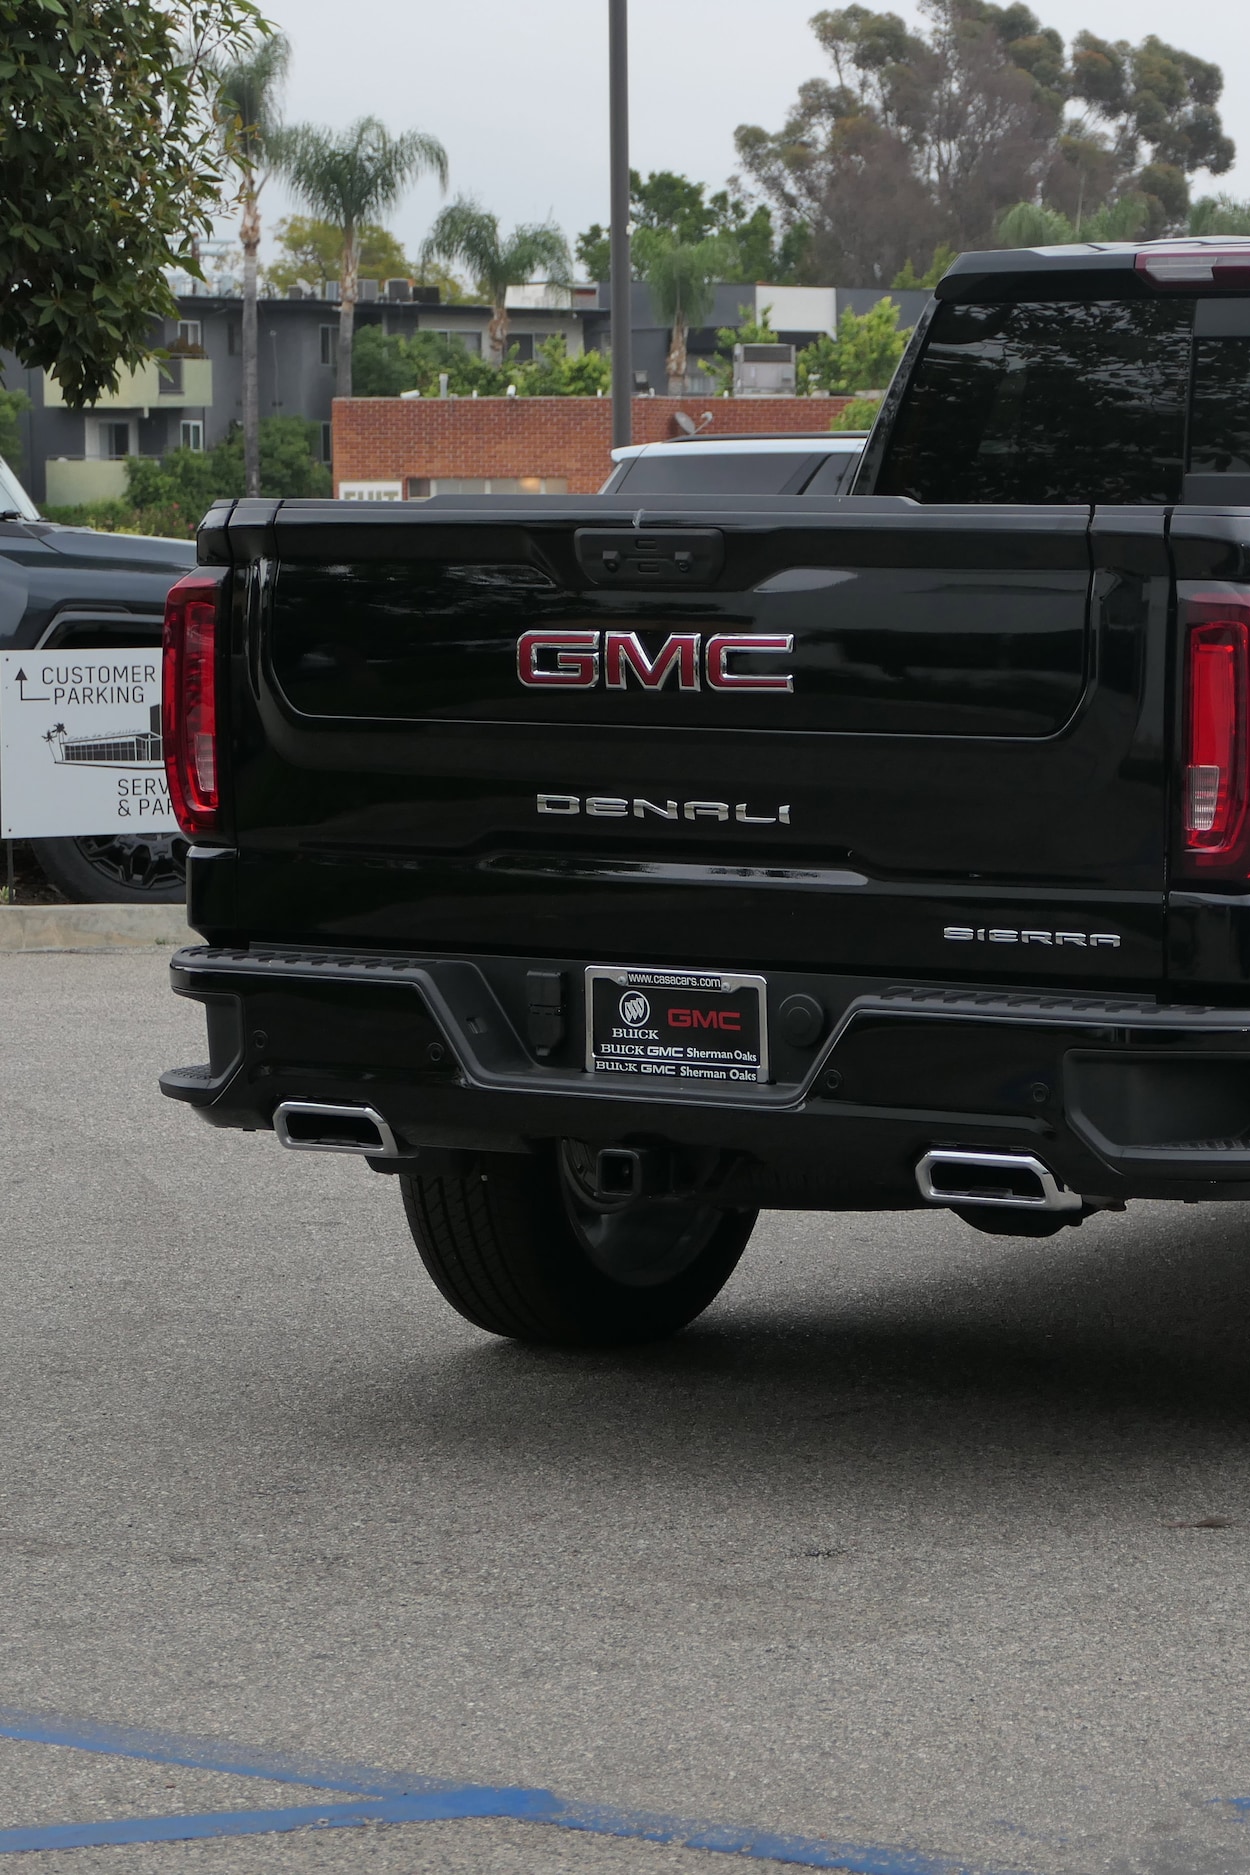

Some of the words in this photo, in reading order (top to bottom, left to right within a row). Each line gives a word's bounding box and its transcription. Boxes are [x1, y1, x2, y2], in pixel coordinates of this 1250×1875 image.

[516, 630, 794, 693] GMC
[41, 665, 156, 684] CUSTOMER
[53, 686, 145, 705] PARKING
[117, 799, 131, 817] &
[536, 793, 791, 825] DENALI
[943, 926, 1121, 948] SIERRA
[628, 973, 721, 988] www.casacars.com
[667, 1008, 741, 1031] GMC
[612, 1027, 659, 1040] BUICK
[600, 1043, 645, 1056] BUICK
[646, 1046, 684, 1057] GMC
[686, 1047, 733, 1060] Sherman
[734, 1050, 757, 1062] Oaks
[595, 1060, 638, 1073] BUICK
[640, 1064, 676, 1075] GMC
[680, 1065, 727, 1080] Sherman
[729, 1069, 757, 1081] Oaks
